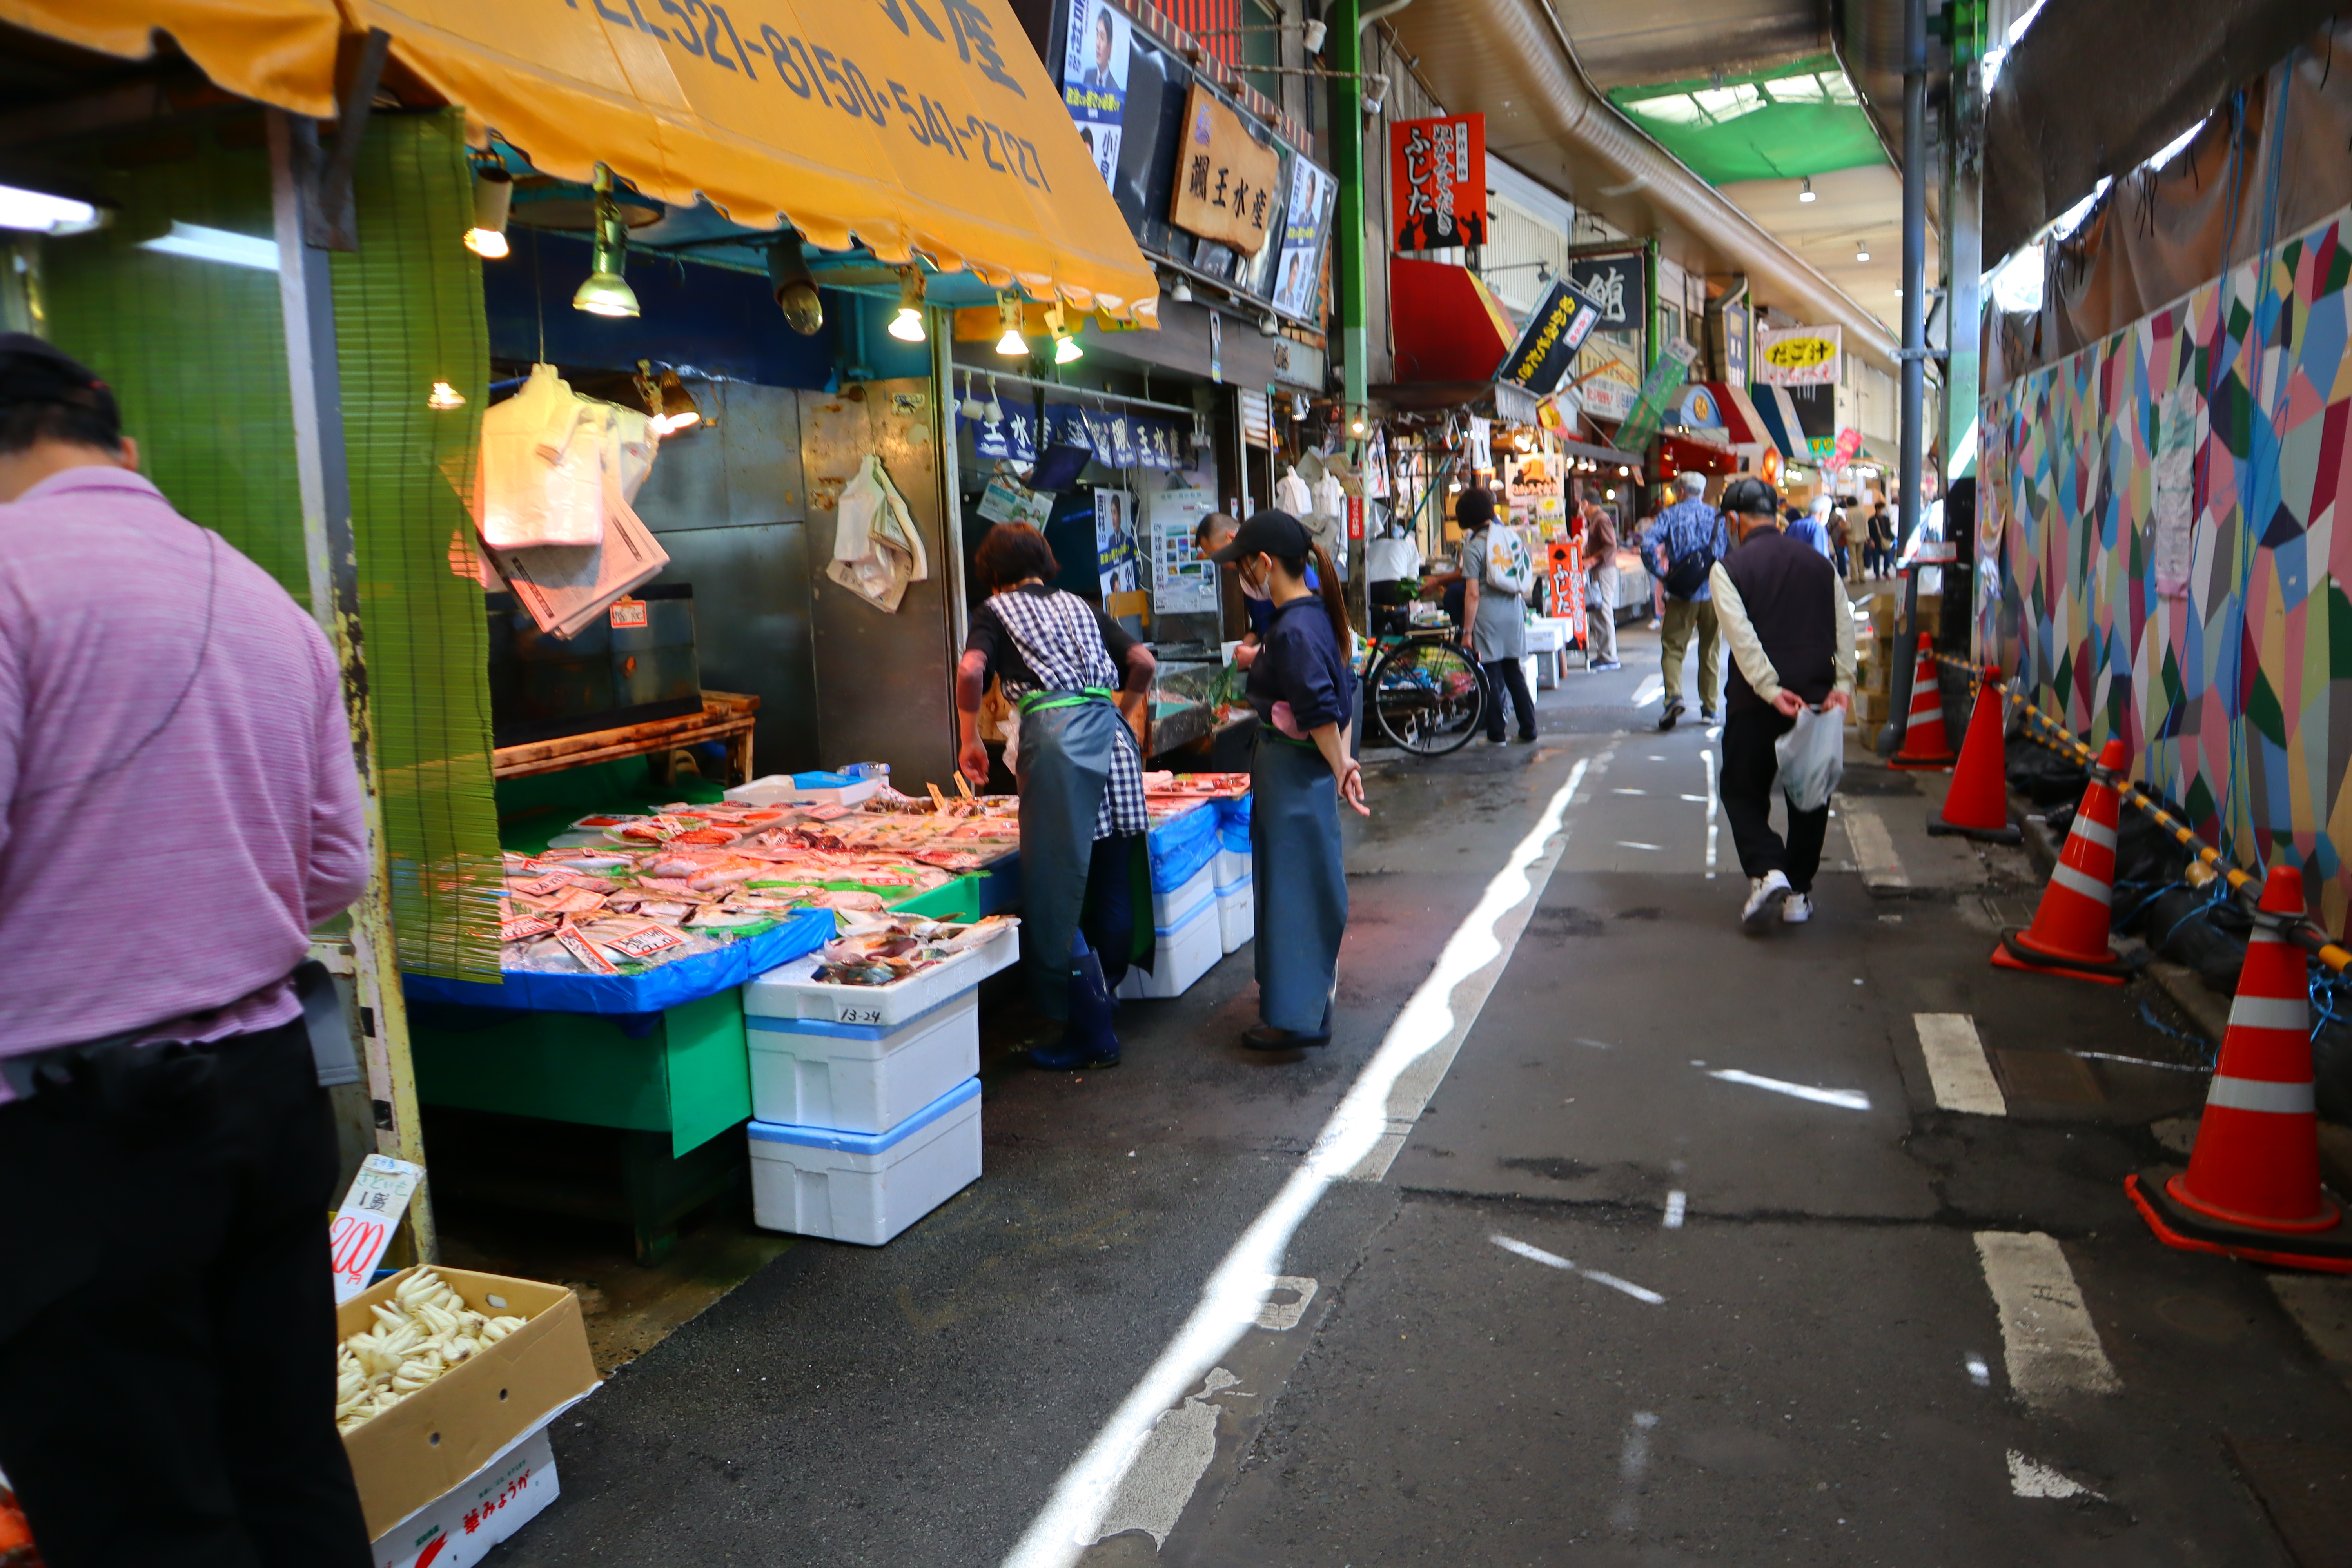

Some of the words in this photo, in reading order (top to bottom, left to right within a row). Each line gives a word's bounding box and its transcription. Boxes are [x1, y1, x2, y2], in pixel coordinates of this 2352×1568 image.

[1404, 126, 1433, 217] ふじた
[1433, 124, 1456, 236] ぬかみそだき
[1586, 266, 1626, 323] 鮪
[1772, 341, 1828, 363] だご汁
[1553, 563, 1572, 615] ふじた
[841, 1008, 880, 1024] 13-24
[331, 1217, 385, 1274] 200
[463, 1468, 530, 1535] 華みょうが
